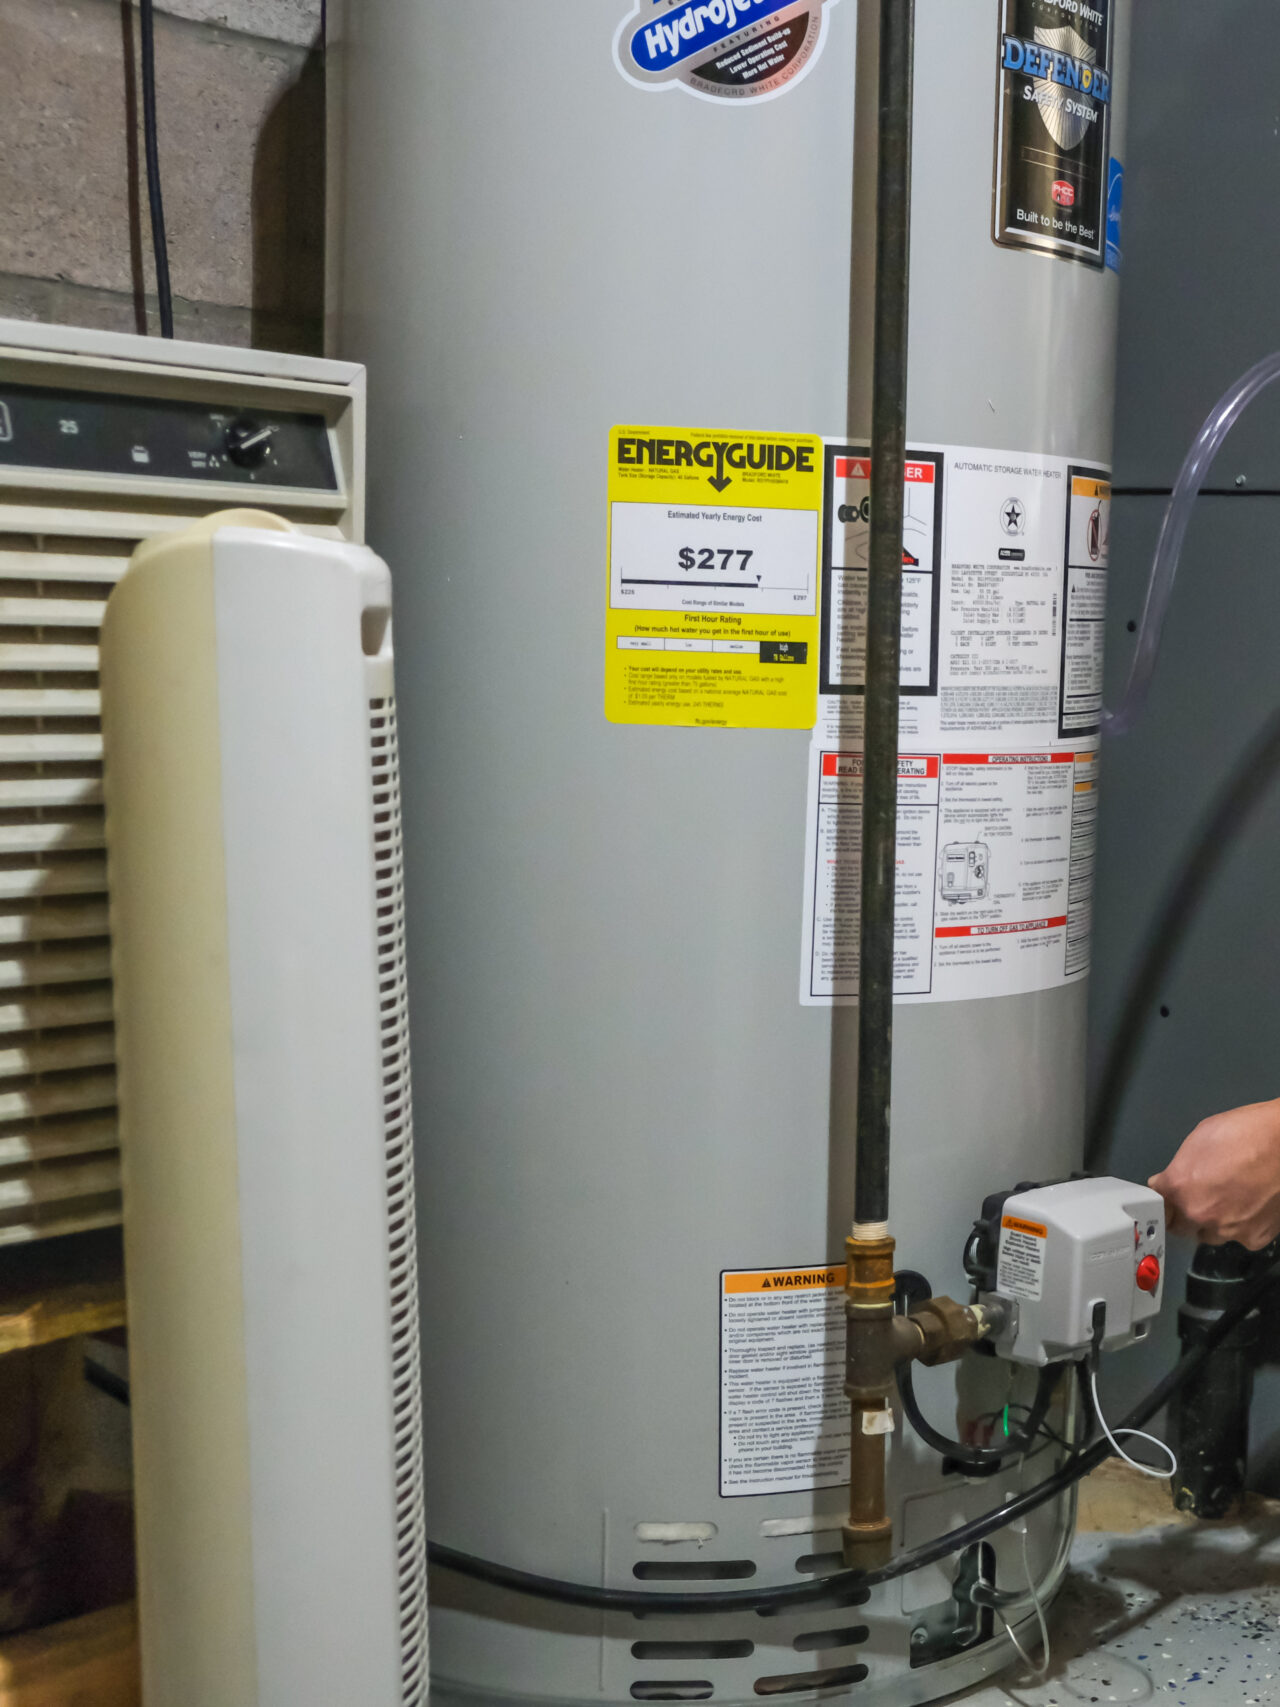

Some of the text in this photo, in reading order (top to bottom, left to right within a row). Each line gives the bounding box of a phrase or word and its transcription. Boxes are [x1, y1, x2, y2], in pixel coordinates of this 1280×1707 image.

[1080, 3, 1104, 26] WHITE
[644, 0, 764, 59] Hydroje
[713, 16, 780, 52] FEATURING
[690, 15, 819, 96] BRADFORD WHITE CORPORATION
[716, 52, 740, 69] Reduced
[730, 61, 747, 74] Lower
[1002, 36, 1110, 104] DEFENDER
[1023, 86, 1098, 122] SAFETY SYSTEM
[1017, 208, 1094, 240] Built to be the Best
[618, 438, 814, 472] ENERGYGUIDE
[954, 462, 992, 472] AUTOMATIC
[994, 466, 1022, 474] STORAGE
[1024, 468, 1042, 477] WATER
[668, 511, 762, 523] Estimated Yearly Energy Cost
[678, 546, 753, 571] $277
[635, 625, 649, 634] (How
[712, 627, 721, 636] get
[778, 629, 790, 637] use)
[685, 614, 699, 622] First
[719, 615, 742, 625] Rating
[773, 1273, 835, 1286] WARNING
